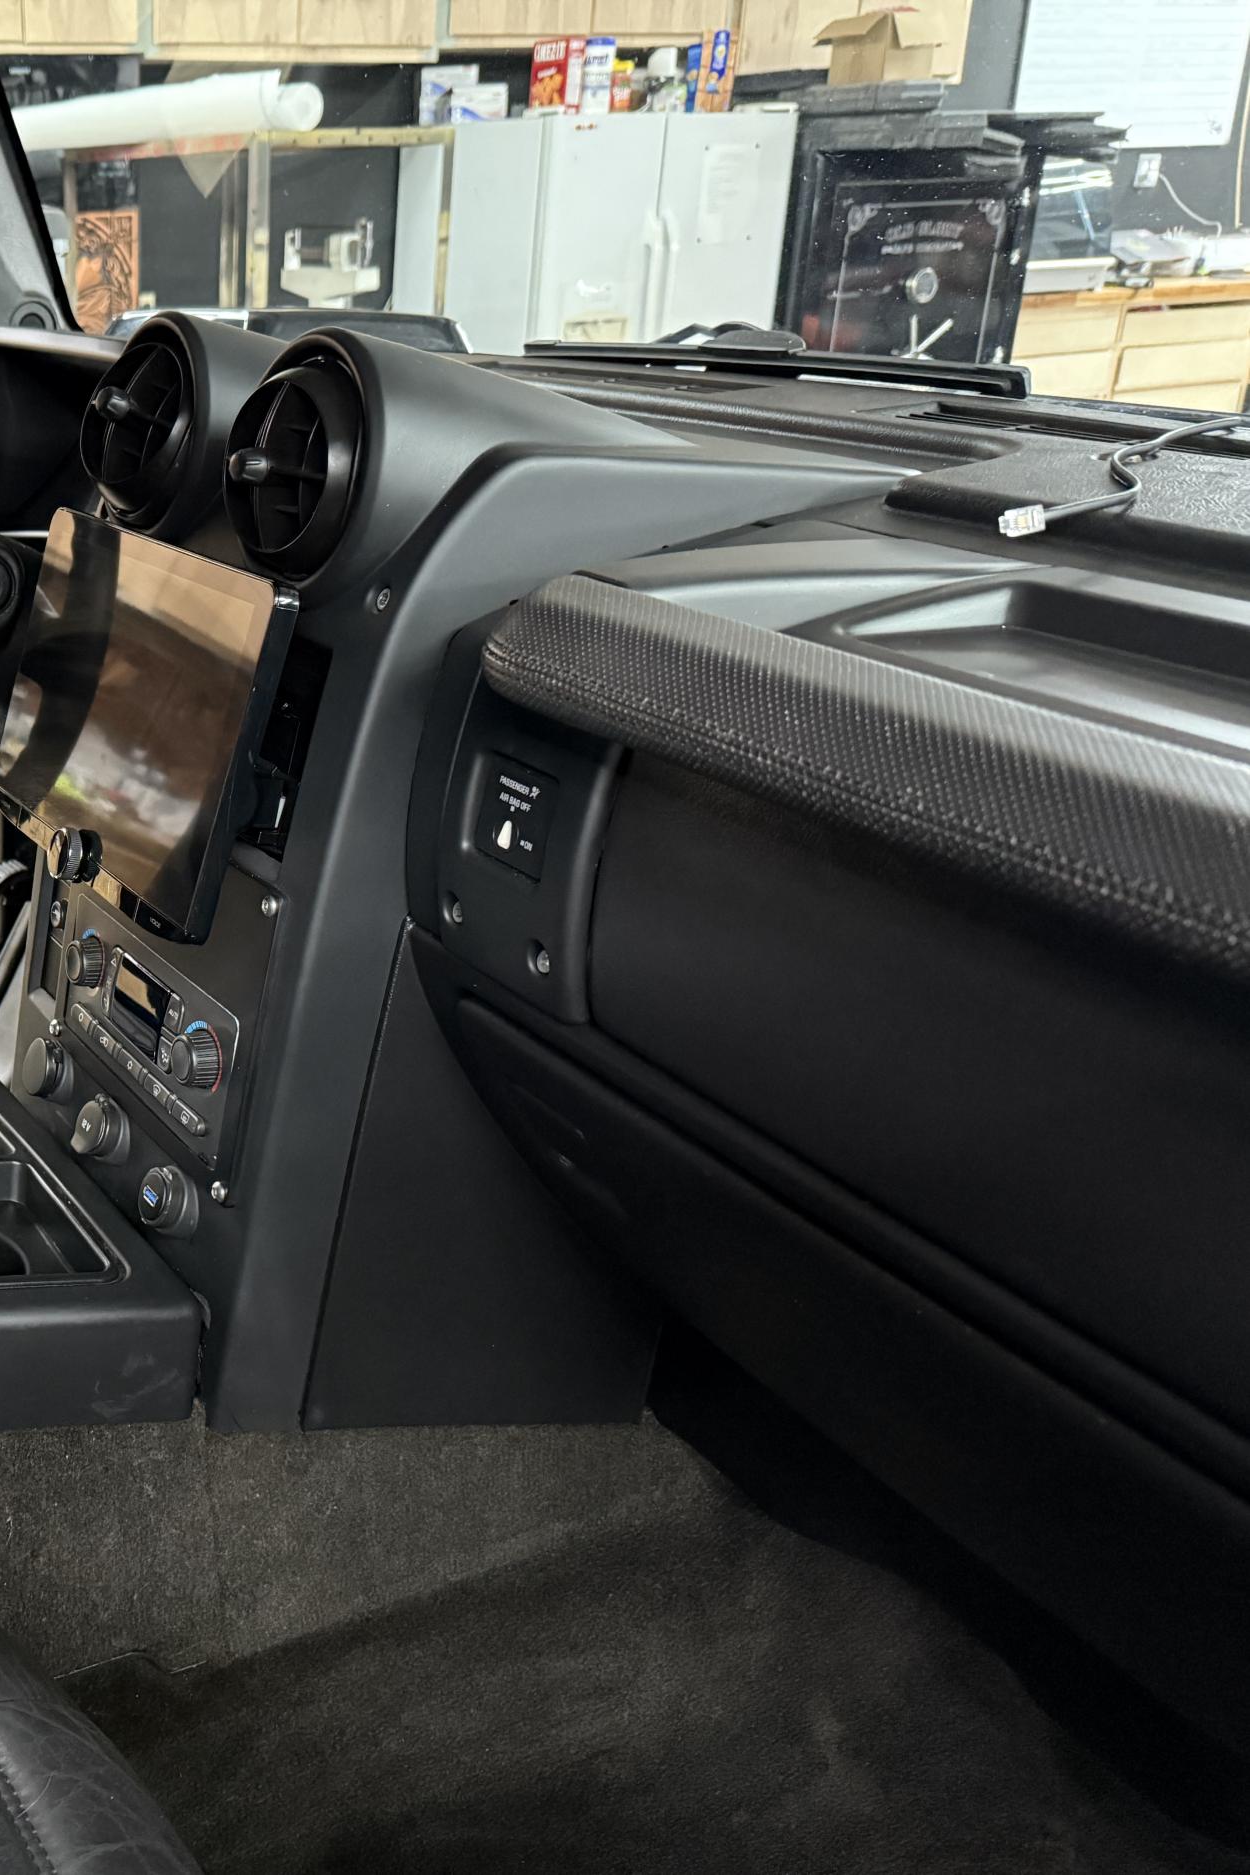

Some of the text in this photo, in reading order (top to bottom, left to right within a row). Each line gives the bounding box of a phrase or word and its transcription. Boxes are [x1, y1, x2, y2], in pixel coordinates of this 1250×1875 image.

[499, 776, 530, 795] PASSENGER
[500, 792, 532, 812] AIR BAG OFF
[524, 841, 533, 851] ON
